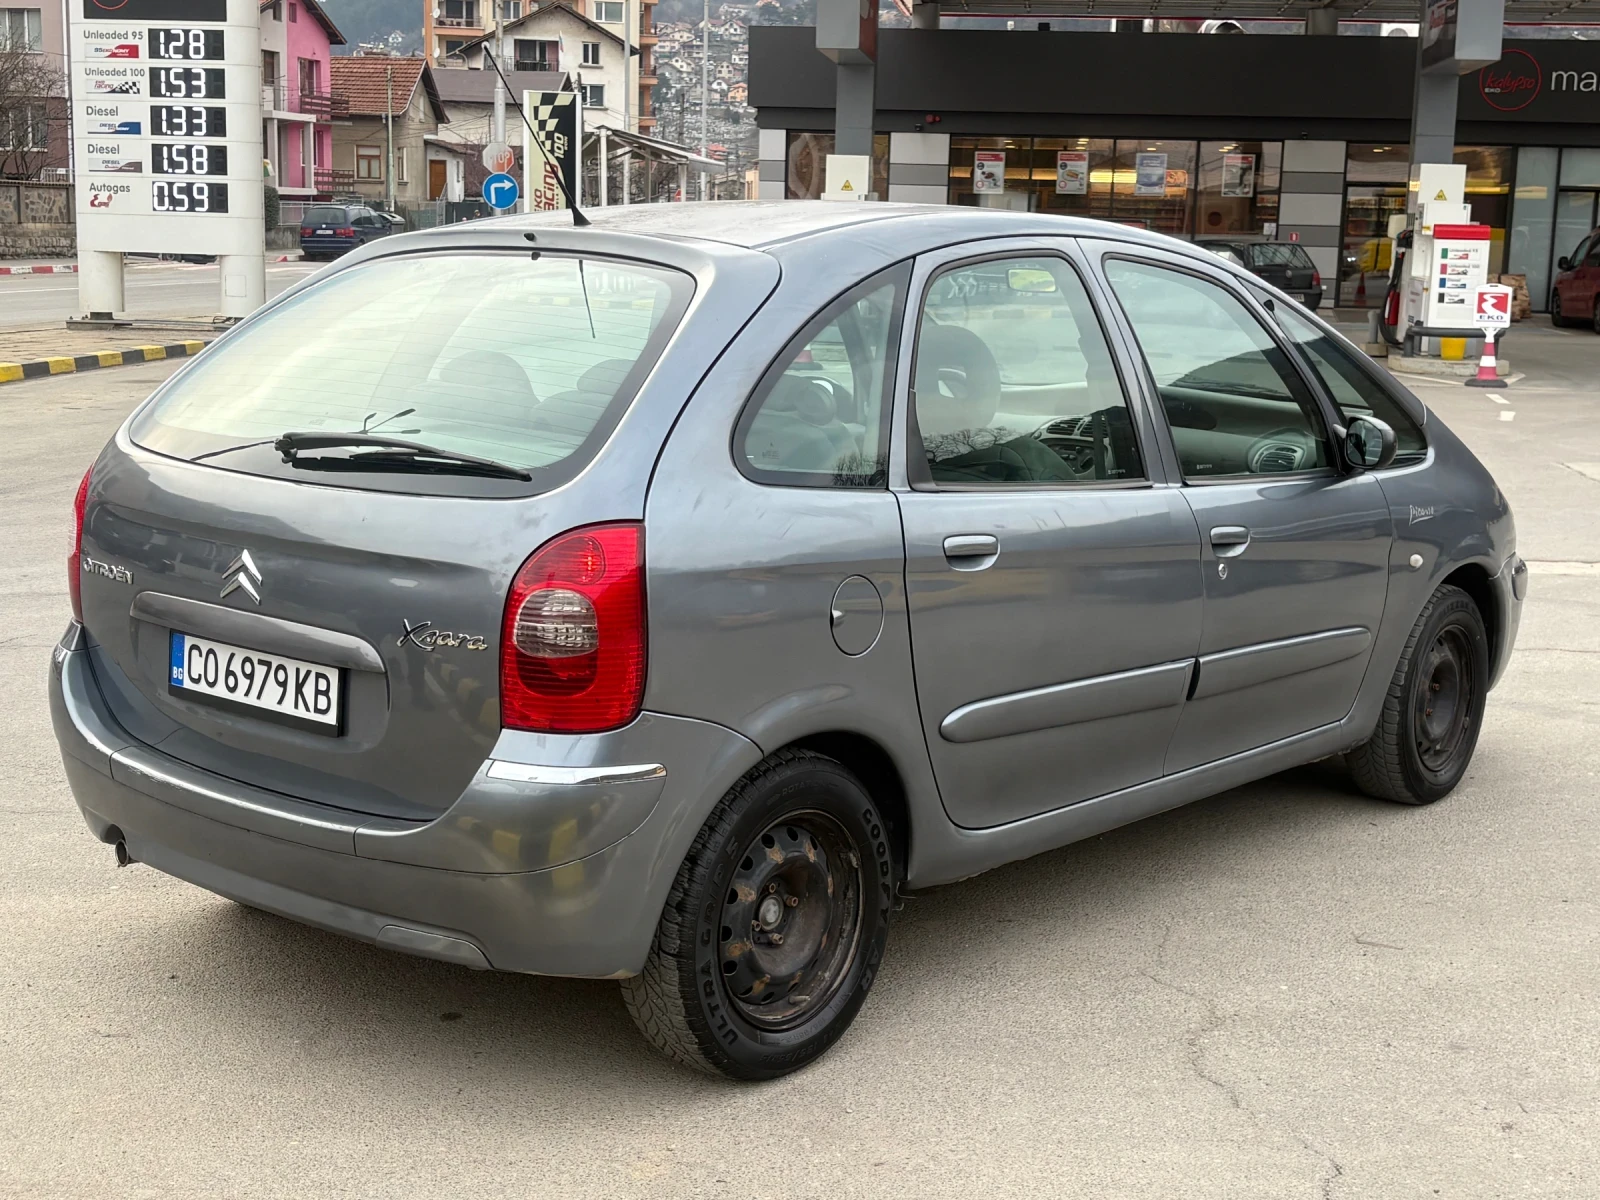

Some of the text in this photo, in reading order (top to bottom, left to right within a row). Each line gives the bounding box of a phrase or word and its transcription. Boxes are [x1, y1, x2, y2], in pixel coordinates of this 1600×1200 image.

[83, 29, 144, 40] Unleaded 95
[159, 29, 205, 59] 1.28
[84, 67, 146, 77] Unleaded 100
[160, 67, 206, 98] 1.53
[1485, 70, 1600, 93] kalypso ma
[85, 105, 119, 117] Diesel
[161, 105, 207, 136] 1.33
[87, 144, 120, 155] Diesel
[162, 144, 208, 175] 1.58
[553, 132, 565, 159] 100
[88, 182, 131, 195] Autogas
[152, 181, 209, 212] 0.59
[543, 160, 559, 212] acing
[82, 557, 134, 585] CITROËN
[396, 618, 489, 652] Xsara
[172, 665, 184, 680] BG
[859, 807, 891, 992] GOODYAR
[700, 959, 740, 1046] ULTRA
